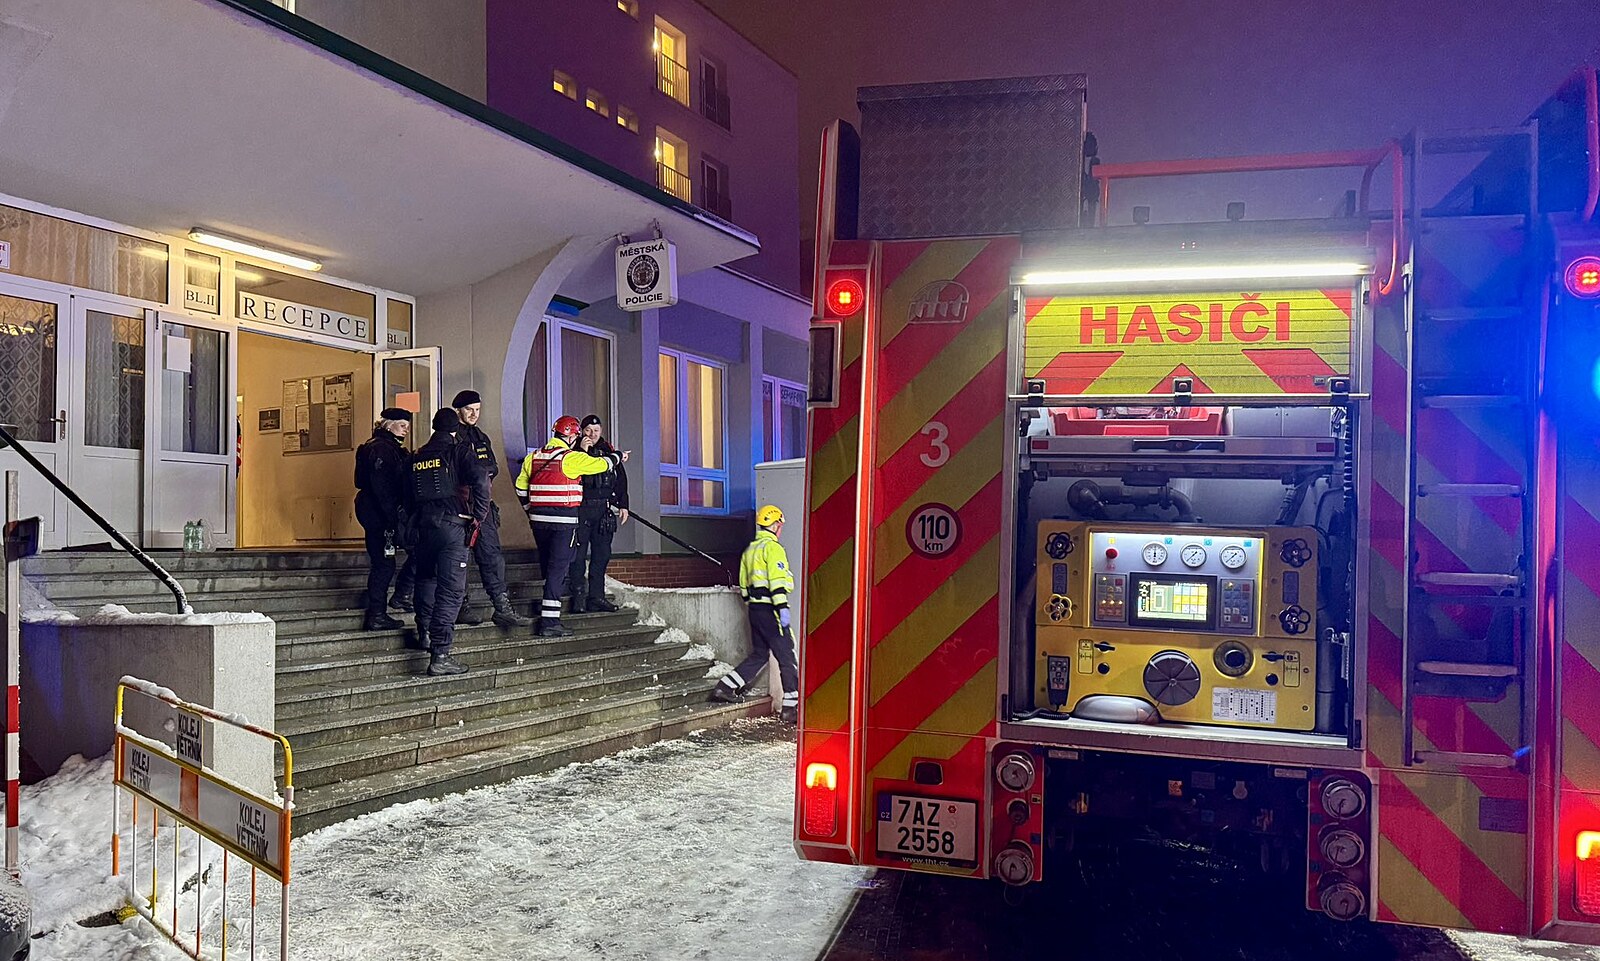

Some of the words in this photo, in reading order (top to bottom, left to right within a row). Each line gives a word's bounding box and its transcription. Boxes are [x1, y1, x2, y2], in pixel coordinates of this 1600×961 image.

[619, 242, 665, 258] MĚSTSKÁ
[625, 292, 663, 305] POLICIE
[243, 296, 367, 339] RECEPCE
[1079, 292, 1290, 344] HASIČI
[919, 421, 951, 468] 3
[412, 458, 441, 472] POLICIE
[918, 514, 950, 540] 110
[924, 539, 943, 551] km
[178, 713, 200, 740] KOLEJ
[131, 748, 150, 773] KOLEJ
[239, 801, 266, 834] KOLEJ
[880, 811, 890, 819] CZ
[898, 799, 941, 827] 7AZ
[897, 826, 955, 855] 2558
[902, 856, 950, 867] www.tht.cz
